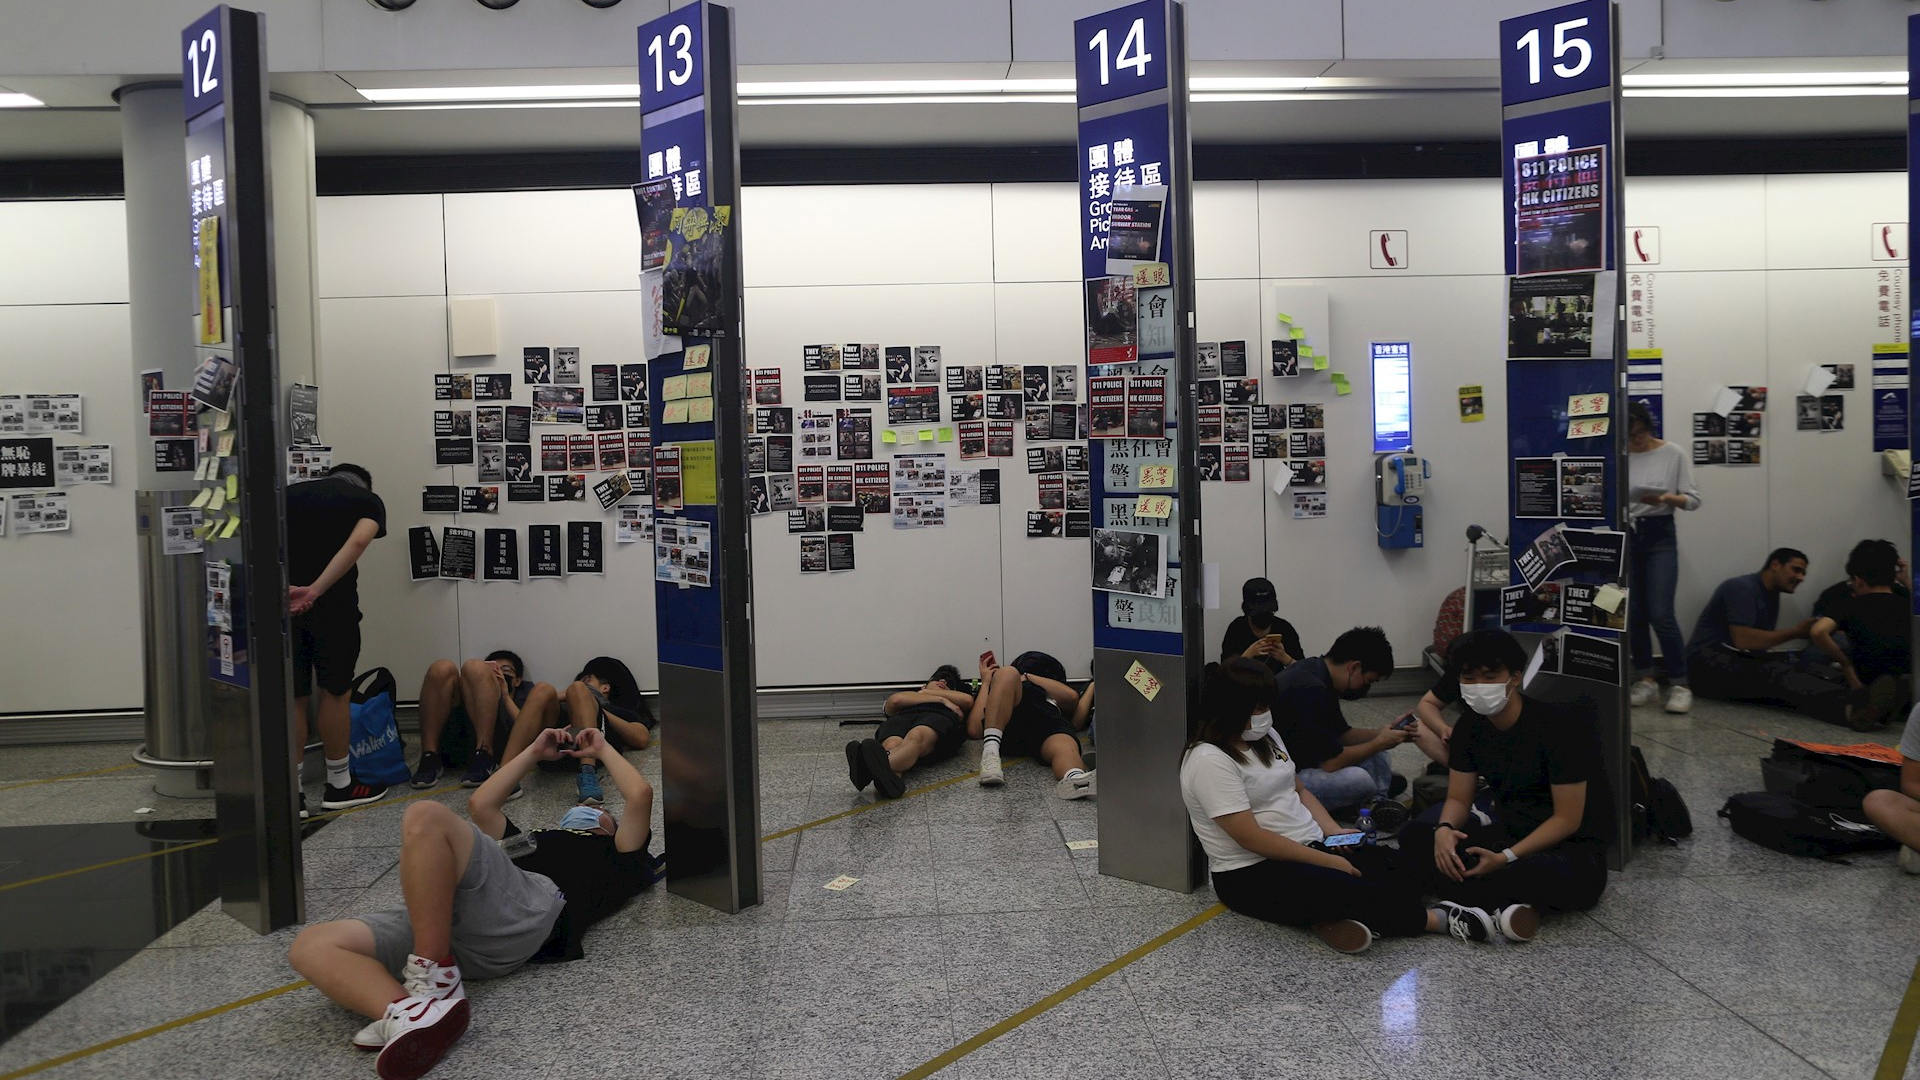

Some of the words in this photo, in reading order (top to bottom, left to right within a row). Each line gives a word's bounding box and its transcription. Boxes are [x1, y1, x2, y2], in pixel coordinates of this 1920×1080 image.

[187, 29, 218, 98] 12
[647, 24, 694, 92] 13
[1089, 18, 1151, 86] 14
[1516, 17, 1593, 84] 15
[1089, 138, 1135, 172] 團體
[1522, 161, 1545, 177] 811
[1548, 153, 1598, 174] POLICE
[672, 169, 702, 201] 待區
[1089, 162, 1162, 200] 接待區
[1522, 192, 1539, 205] HK
[1542, 184, 1598, 203] CITIZENS
[1090, 216, 1111, 233] Pic
[1631, 274, 1642, 333] 免費電話
[1646, 273, 1654, 314] Courtesy
[1878, 270, 1890, 328] 免費電話
[1893, 269, 1902, 310] Courtesy
[1646, 318, 1654, 348] phone
[1893, 313, 1902, 343] phone
[1130, 380, 1140, 388] 811
[1110, 436, 1173, 458] 黑社會
[1110, 464, 1129, 487] 警
[1518, 548, 1534, 566] THEY
[1505, 590, 1524, 600] THEY
[1568, 587, 1589, 598] THEY
[1114, 599, 1134, 623] 警
